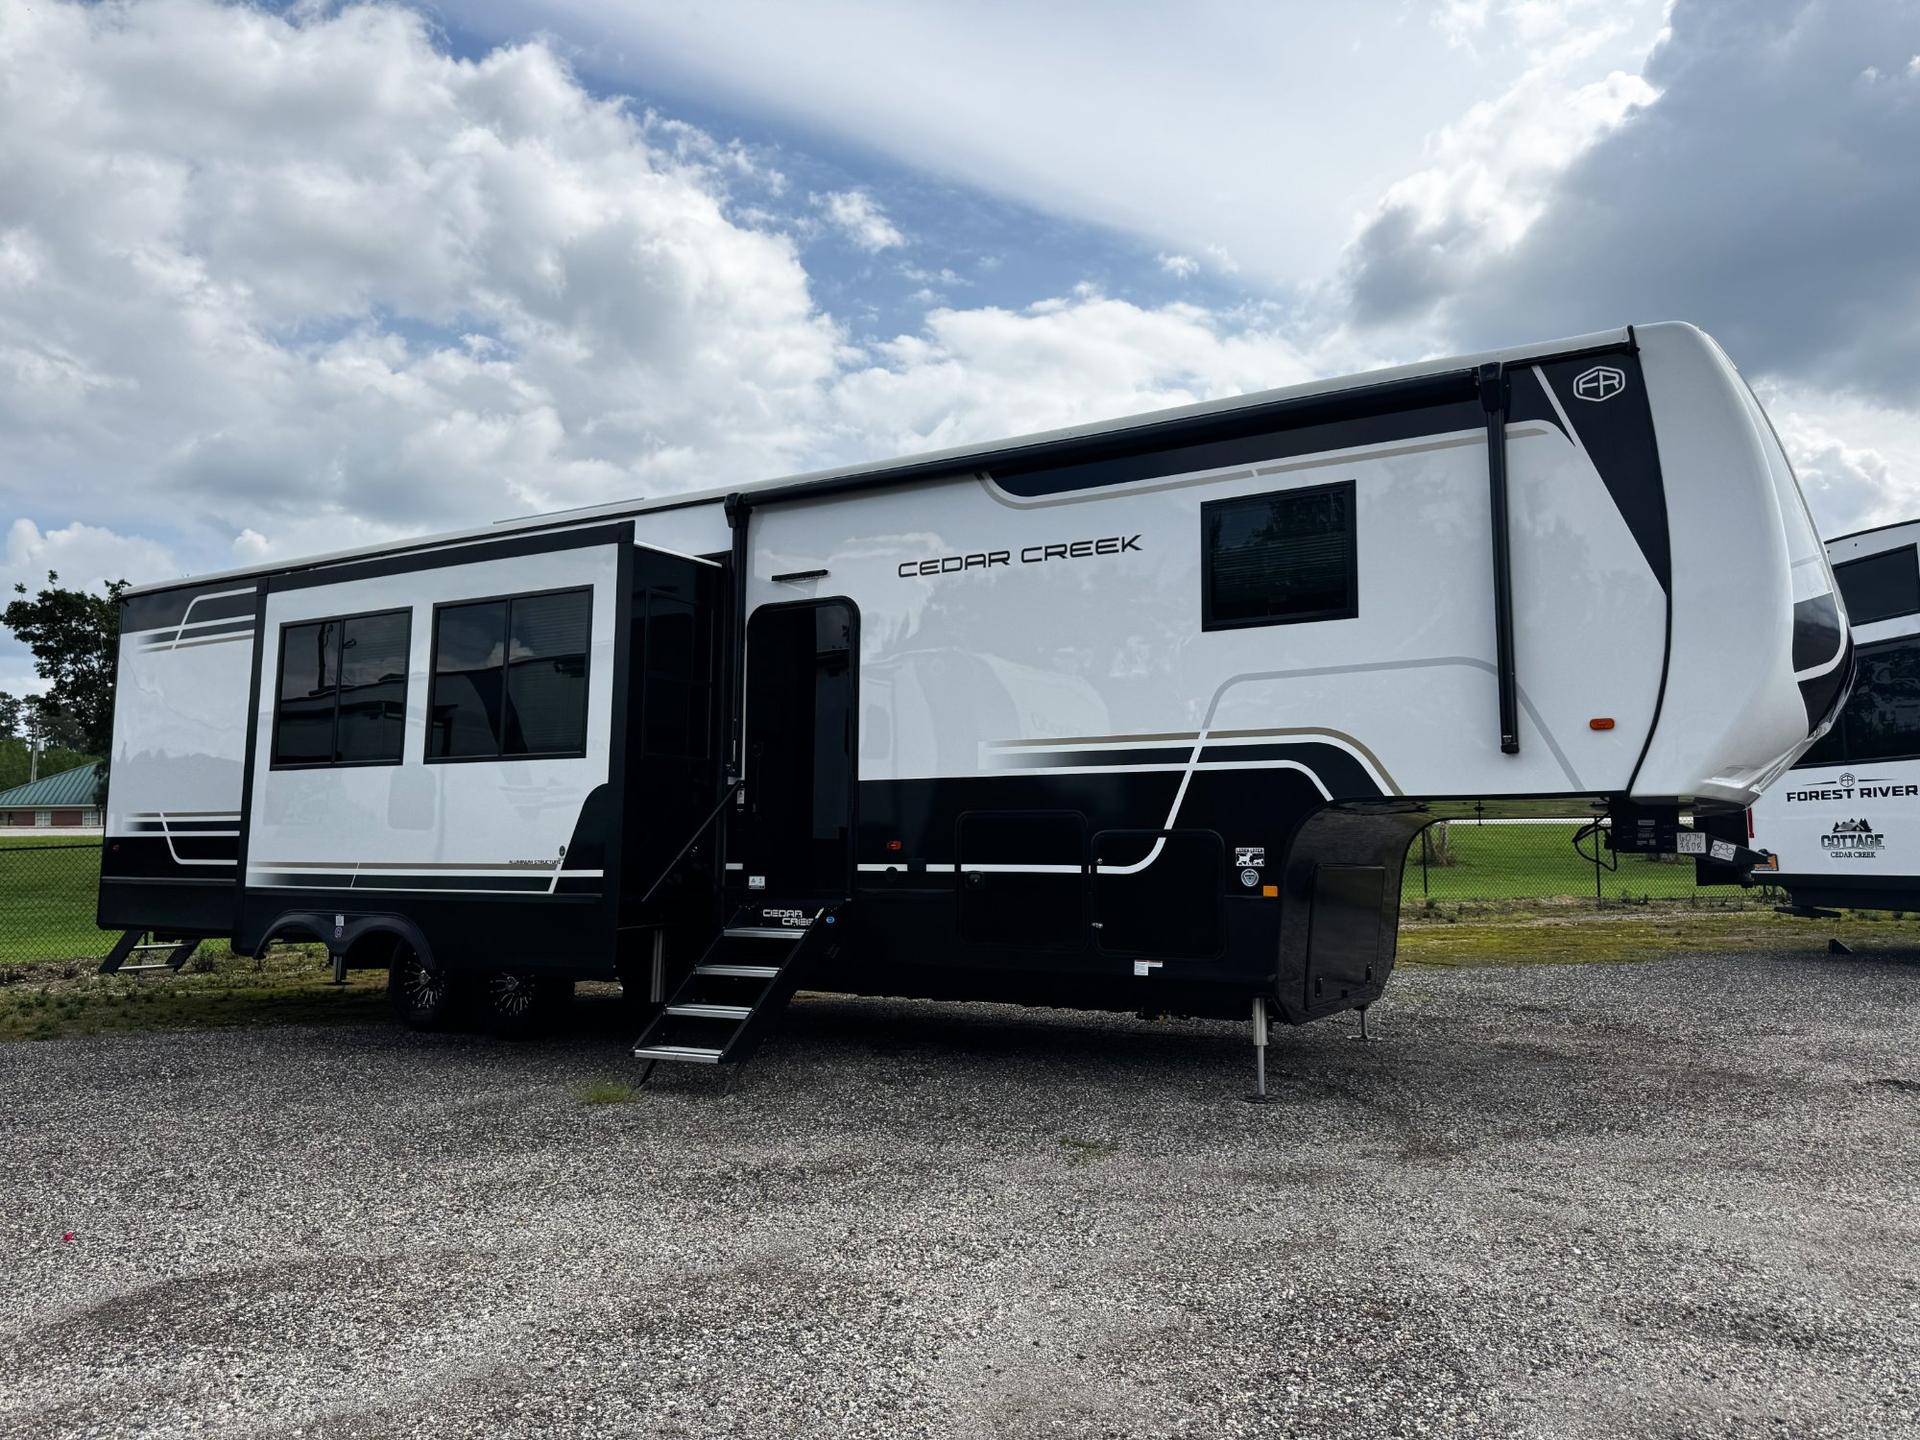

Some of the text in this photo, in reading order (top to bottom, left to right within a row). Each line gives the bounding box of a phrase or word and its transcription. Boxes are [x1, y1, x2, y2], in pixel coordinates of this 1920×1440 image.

[898, 534, 1144, 578] CEDAR CREEK
[1786, 785, 1919, 802] FOREST RIVER
[1820, 833, 1885, 850] COTTAGE
[762, 909, 803, 918] CEDAR
